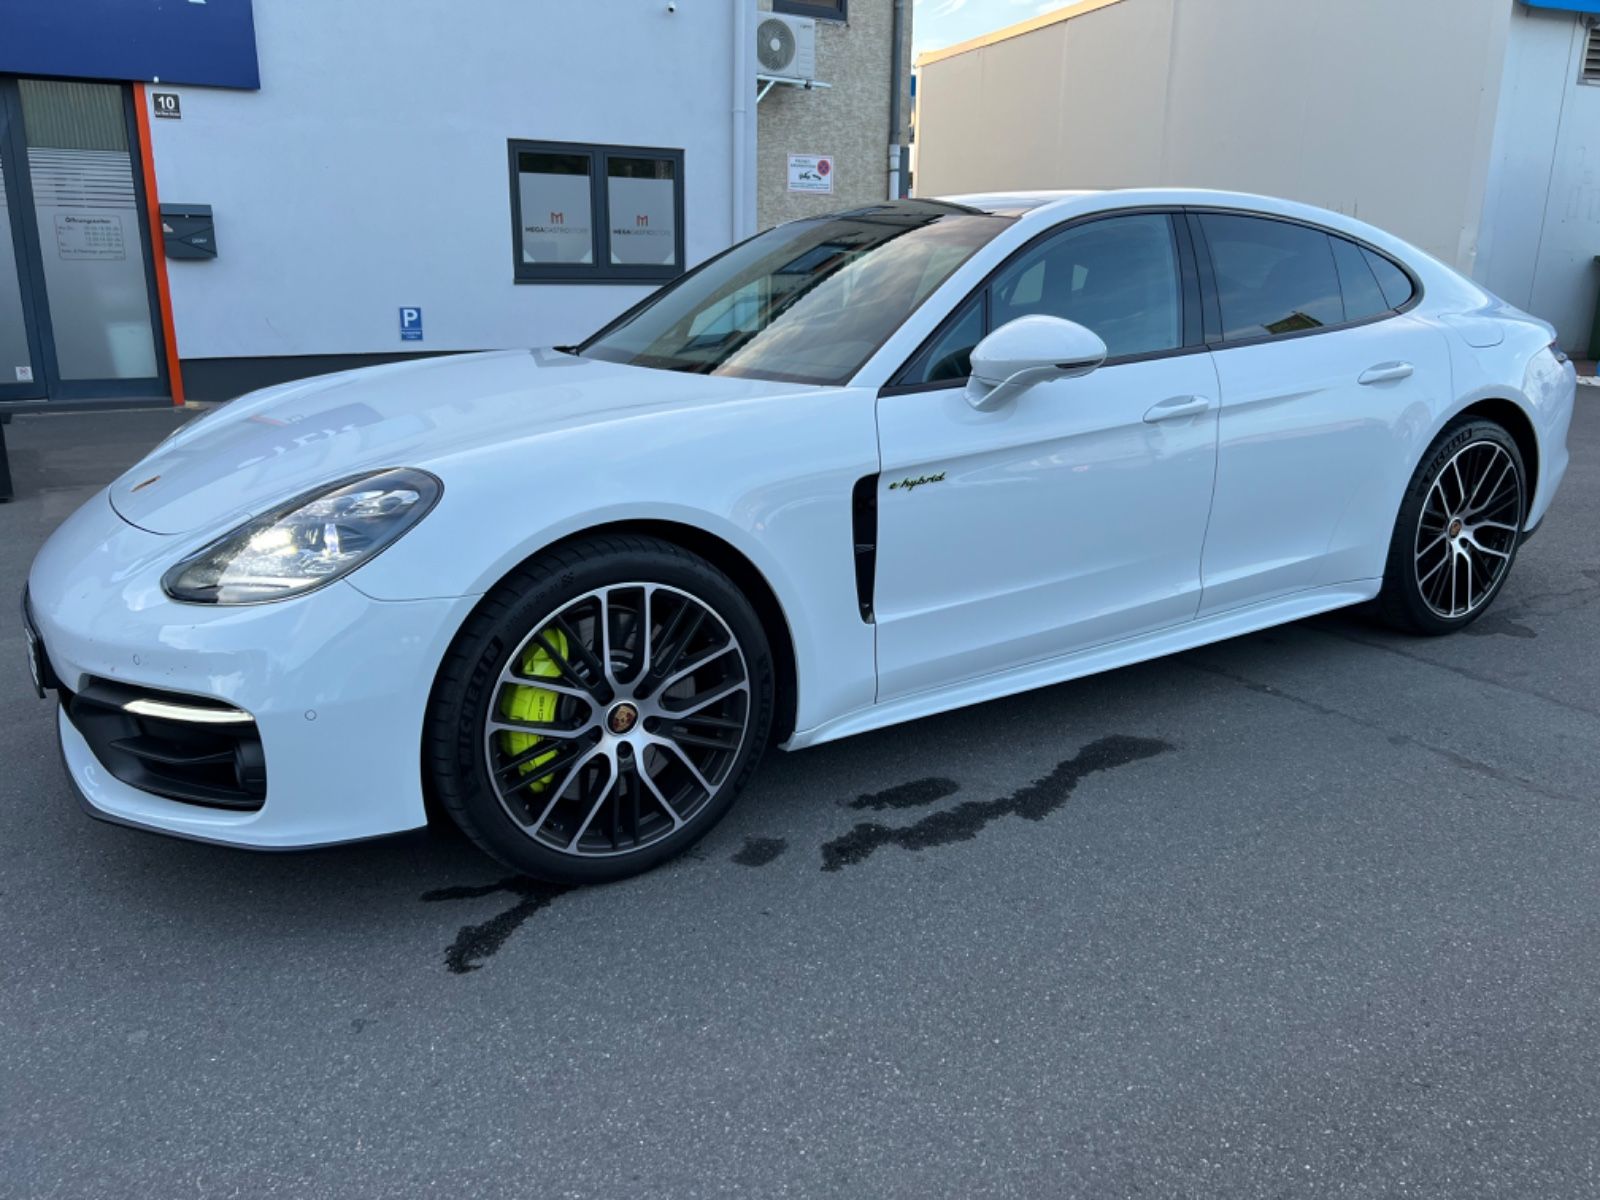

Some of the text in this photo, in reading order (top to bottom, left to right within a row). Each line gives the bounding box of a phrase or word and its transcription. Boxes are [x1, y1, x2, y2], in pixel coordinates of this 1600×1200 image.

[158, 96, 175, 109] 10
[403, 309, 418, 328] P
[459, 637, 503, 769] MICHELIN
